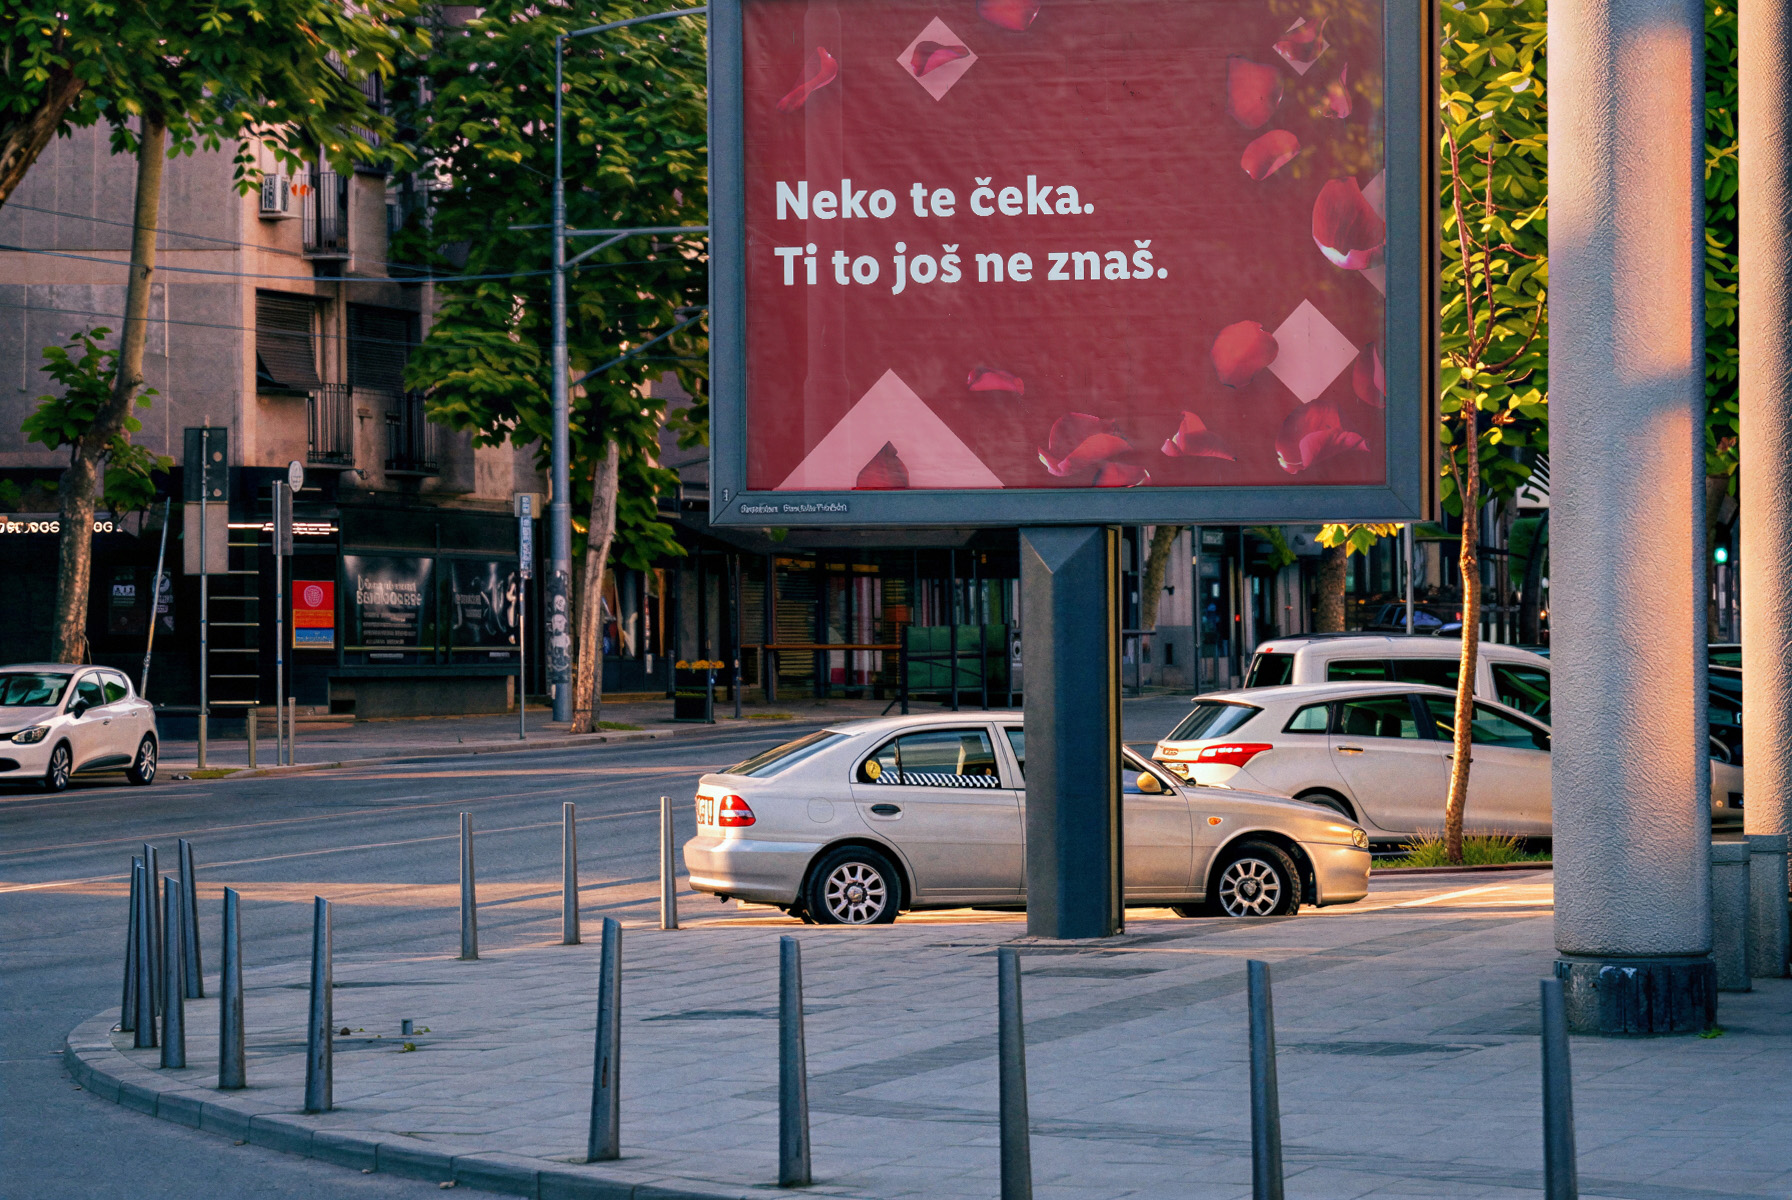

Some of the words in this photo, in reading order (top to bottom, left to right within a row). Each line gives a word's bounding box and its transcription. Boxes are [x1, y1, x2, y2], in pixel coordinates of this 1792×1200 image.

[775, 178, 897, 220] Neko
[909, 182, 956, 218] te
[969, 174, 1095, 217] čeka.
[773, 242, 818, 286] Ti
[831, 250, 880, 286] to
[891, 241, 962, 296] još
[975, 251, 1033, 283] ne
[1047, 239, 1169, 281] znaš.
